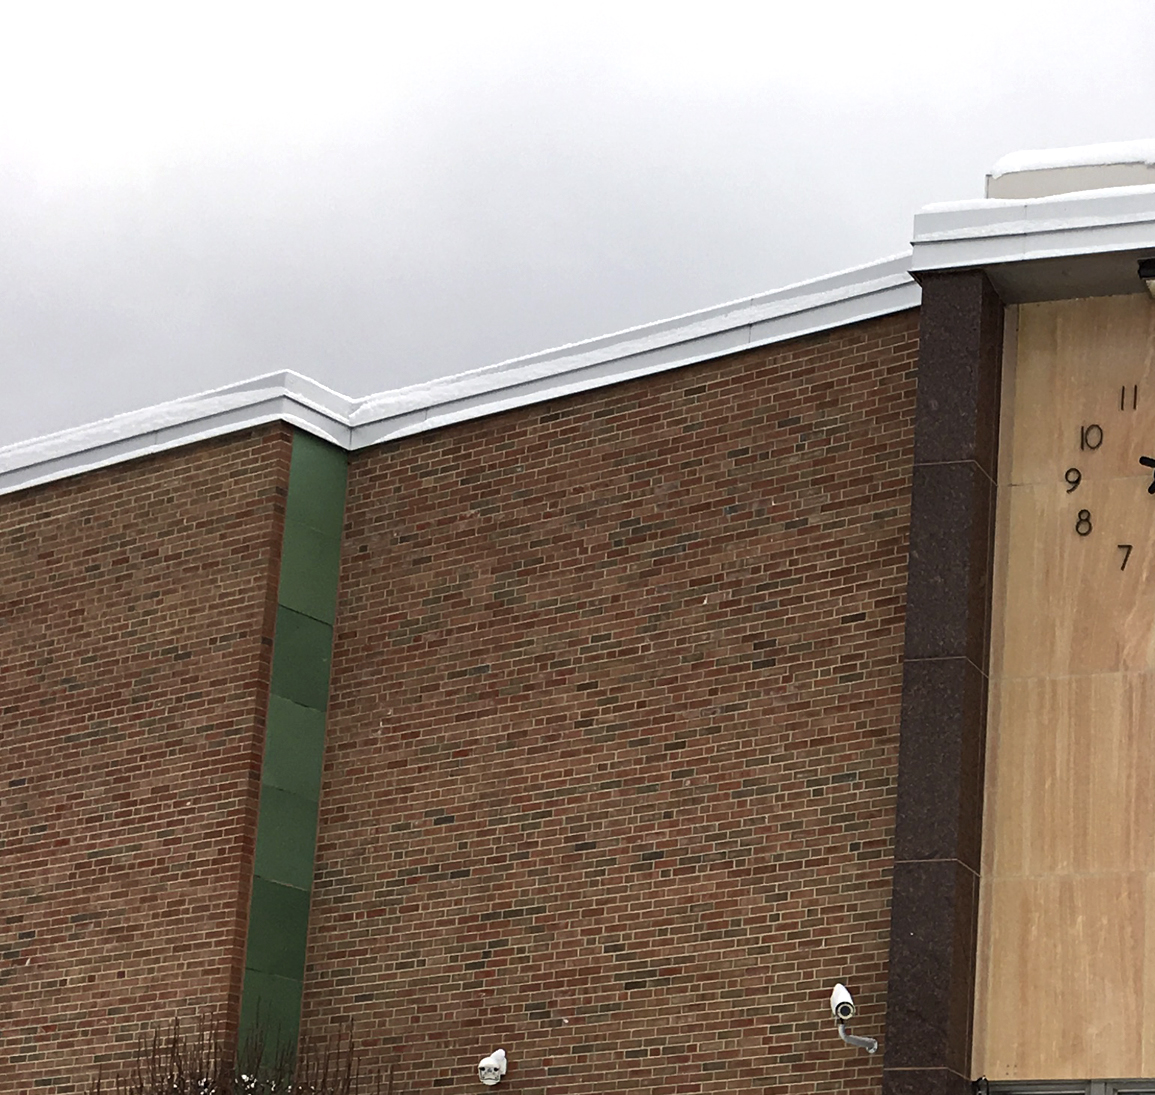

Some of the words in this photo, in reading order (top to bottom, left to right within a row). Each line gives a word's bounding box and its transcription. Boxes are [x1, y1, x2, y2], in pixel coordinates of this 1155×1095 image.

[1120, 384, 1138, 411] 11
[1080, 424, 1104, 451] 10
[1065, 468, 1082, 494] 9
[1075, 509, 1092, 537] 8
[1117, 545, 1133, 571] 7
